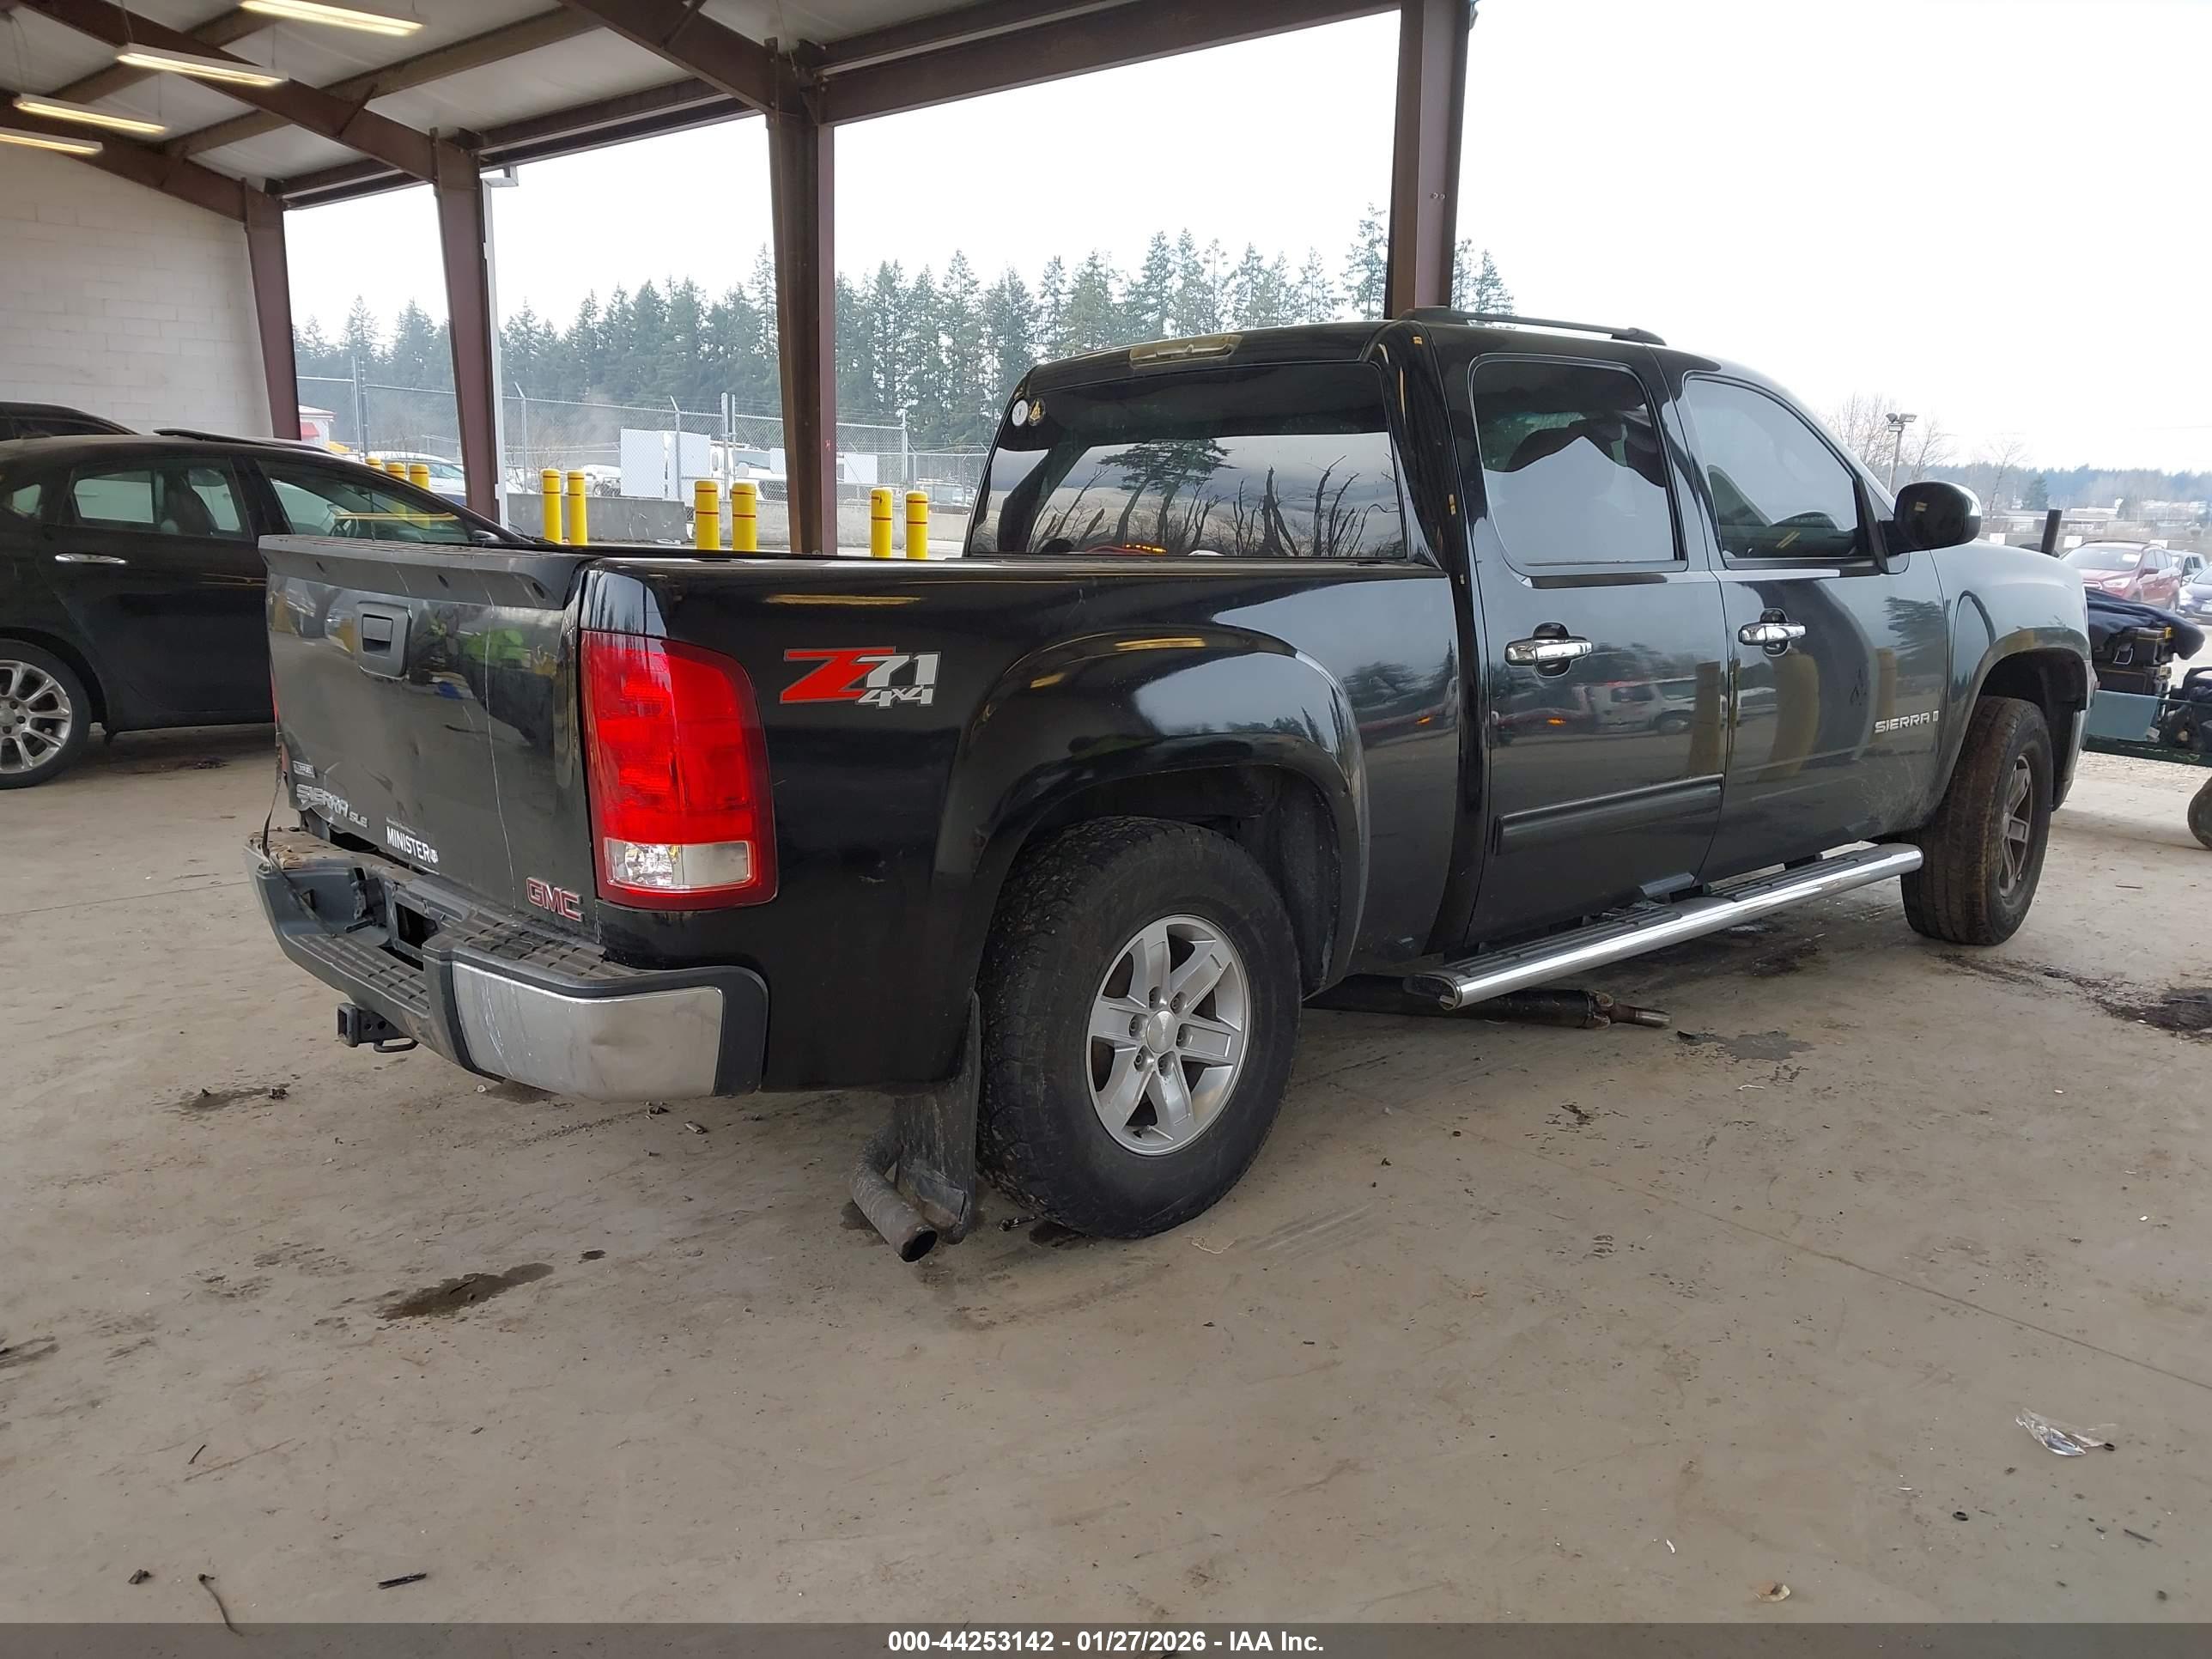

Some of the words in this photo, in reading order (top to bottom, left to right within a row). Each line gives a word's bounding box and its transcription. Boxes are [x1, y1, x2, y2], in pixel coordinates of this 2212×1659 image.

[780, 646, 941, 704] Z71
[1874, 712, 1930, 734] SIERRA
[386, 825, 432, 863] MINISTER
[526, 877, 584, 922] GMC
